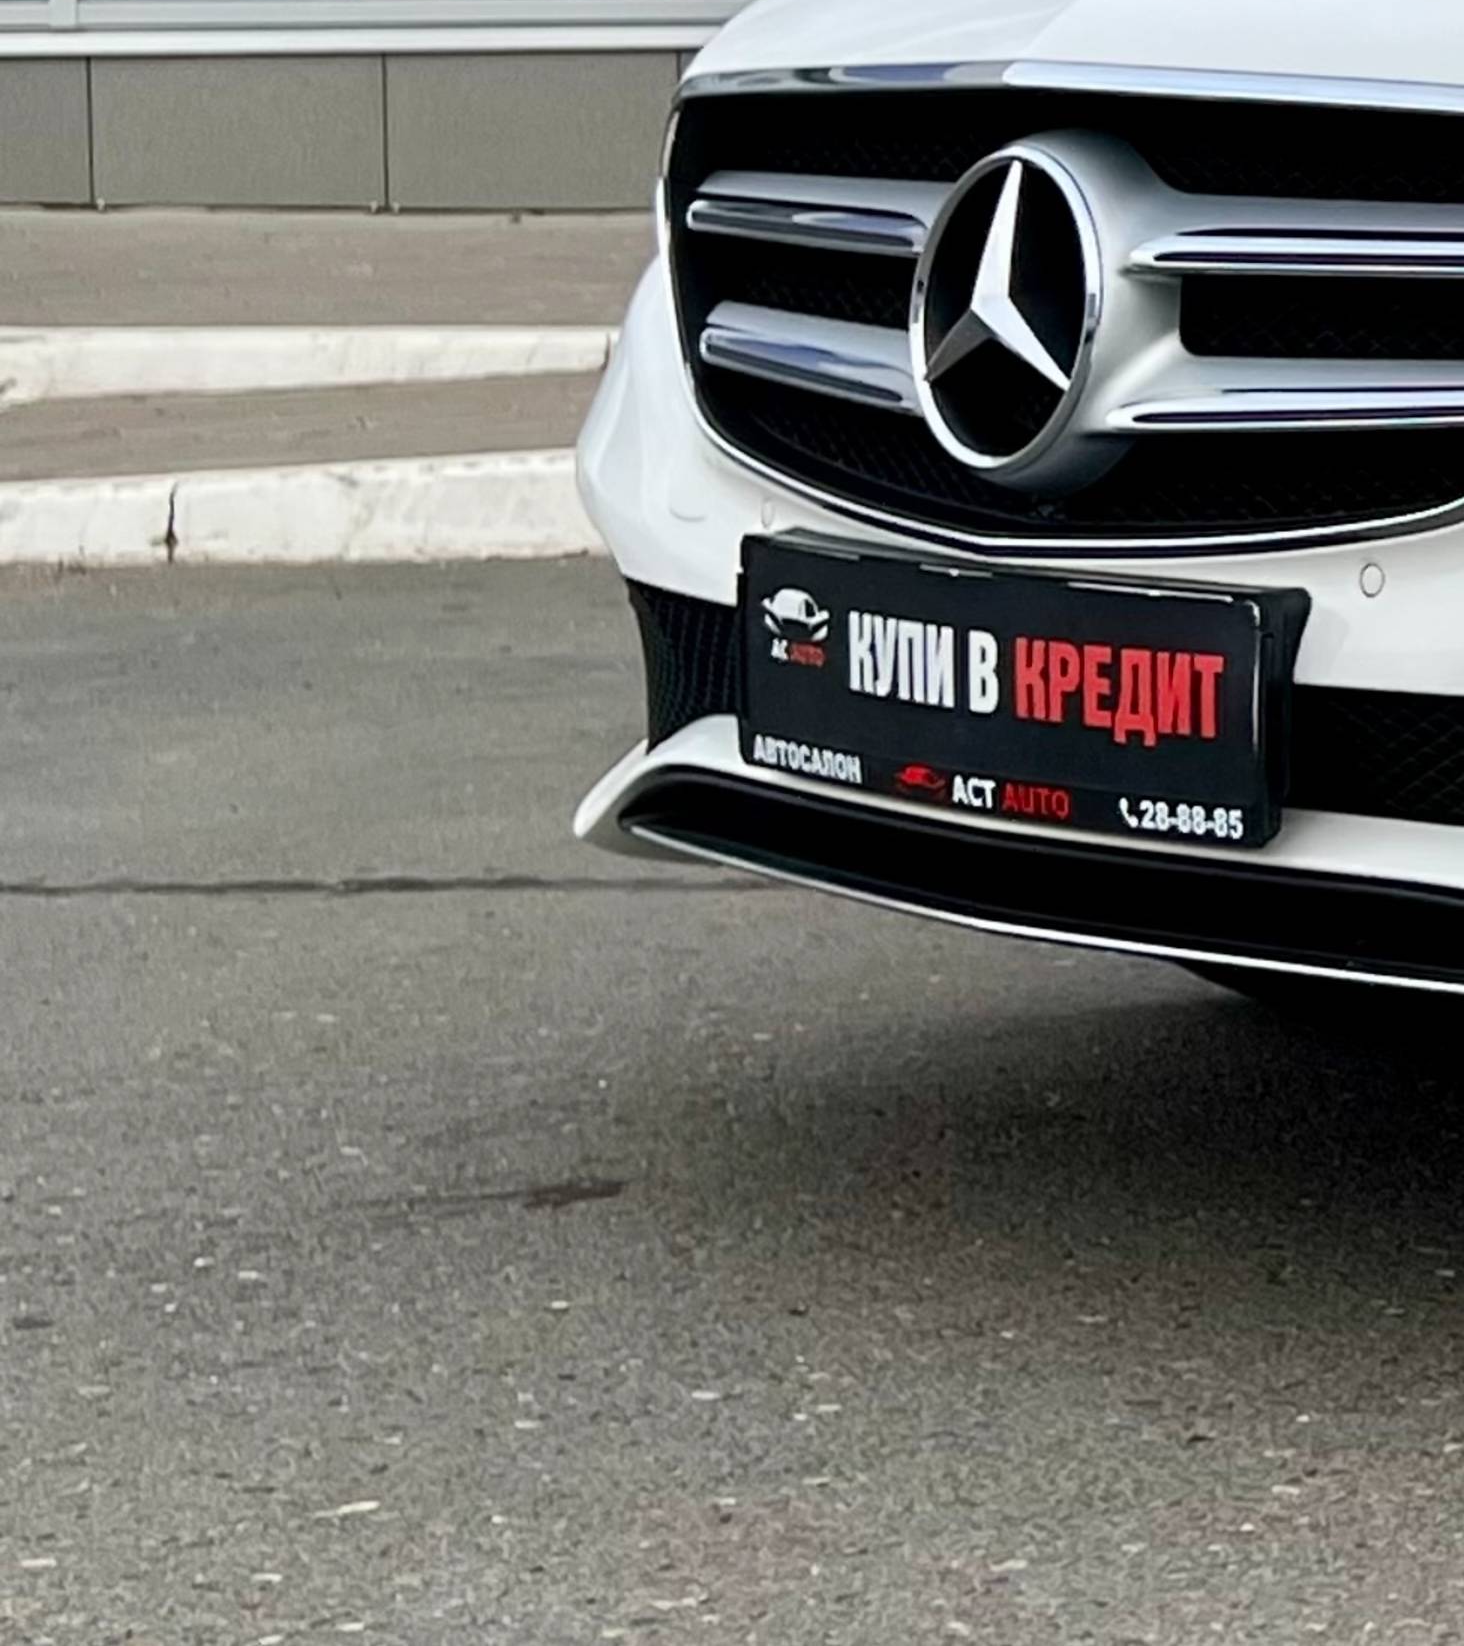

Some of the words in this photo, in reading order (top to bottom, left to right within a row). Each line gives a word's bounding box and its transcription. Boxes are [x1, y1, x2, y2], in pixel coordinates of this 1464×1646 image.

[848, 610, 955, 709] КУПИ
[968, 630, 999, 714] В
[1014, 636, 1225, 747] КРЕДИТ
[753, 734, 862, 784] АВТОСАЛОН
[1002, 782, 1069, 819] AUTO
[1138, 799, 1244, 839] 28-88-85
